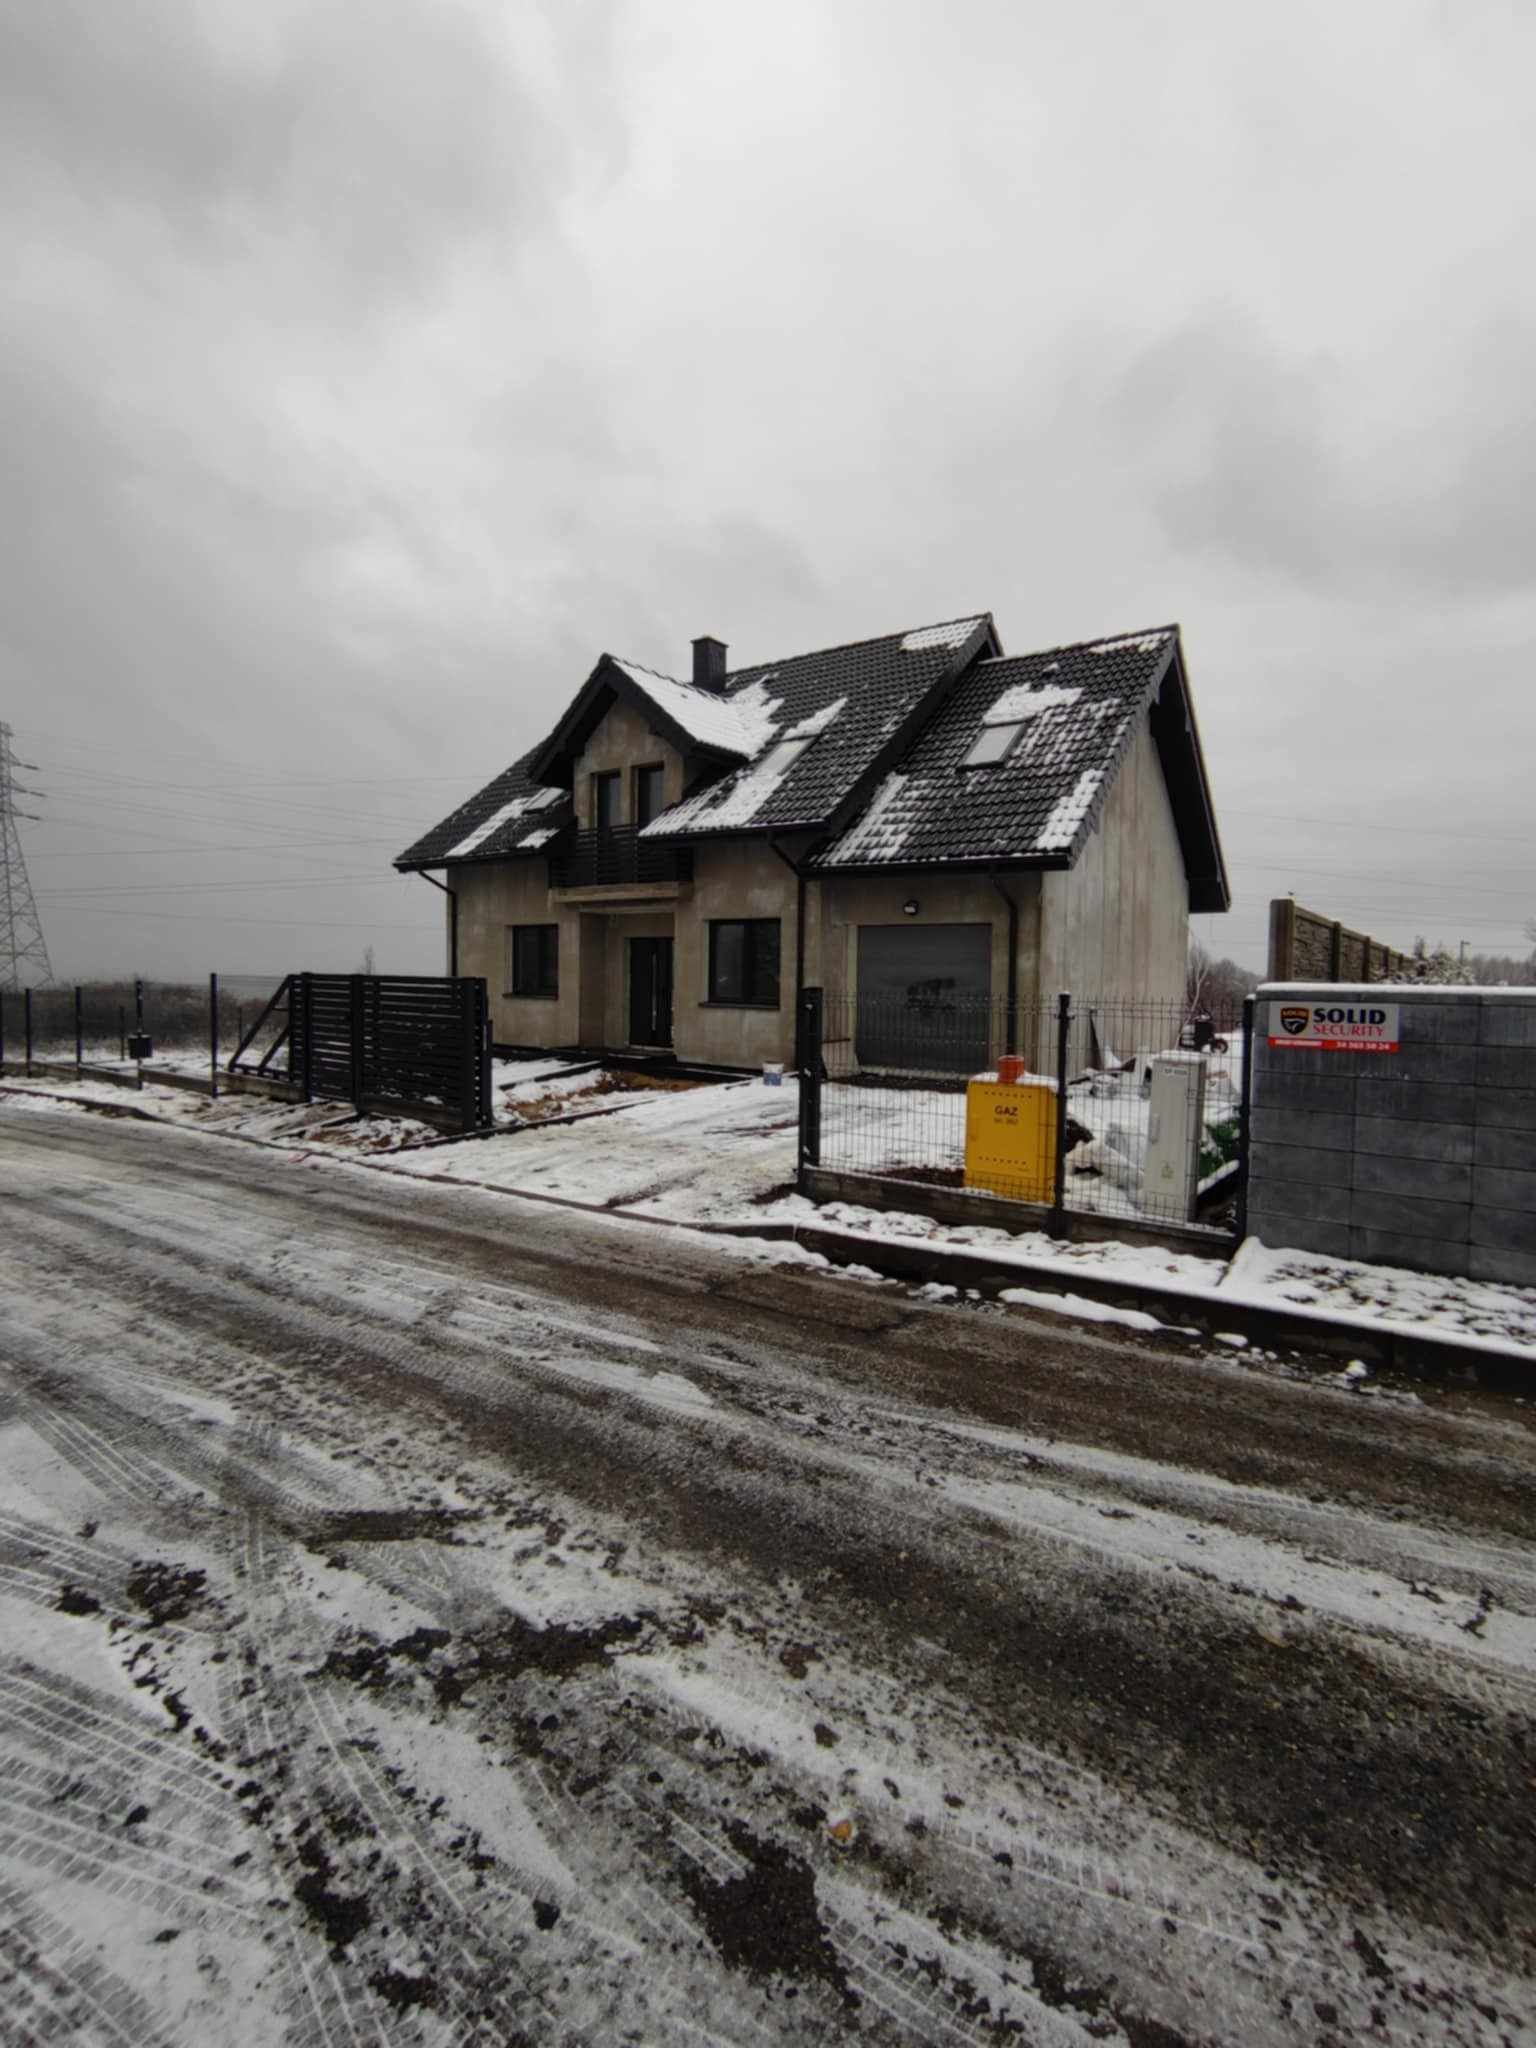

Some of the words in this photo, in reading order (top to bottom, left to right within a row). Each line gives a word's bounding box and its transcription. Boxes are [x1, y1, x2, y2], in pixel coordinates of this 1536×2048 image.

[1313, 1007, 1386, 1025] SOLID
[1313, 1023, 1384, 1036] SECURITY
[994, 1105, 1018, 1117] GAZ
